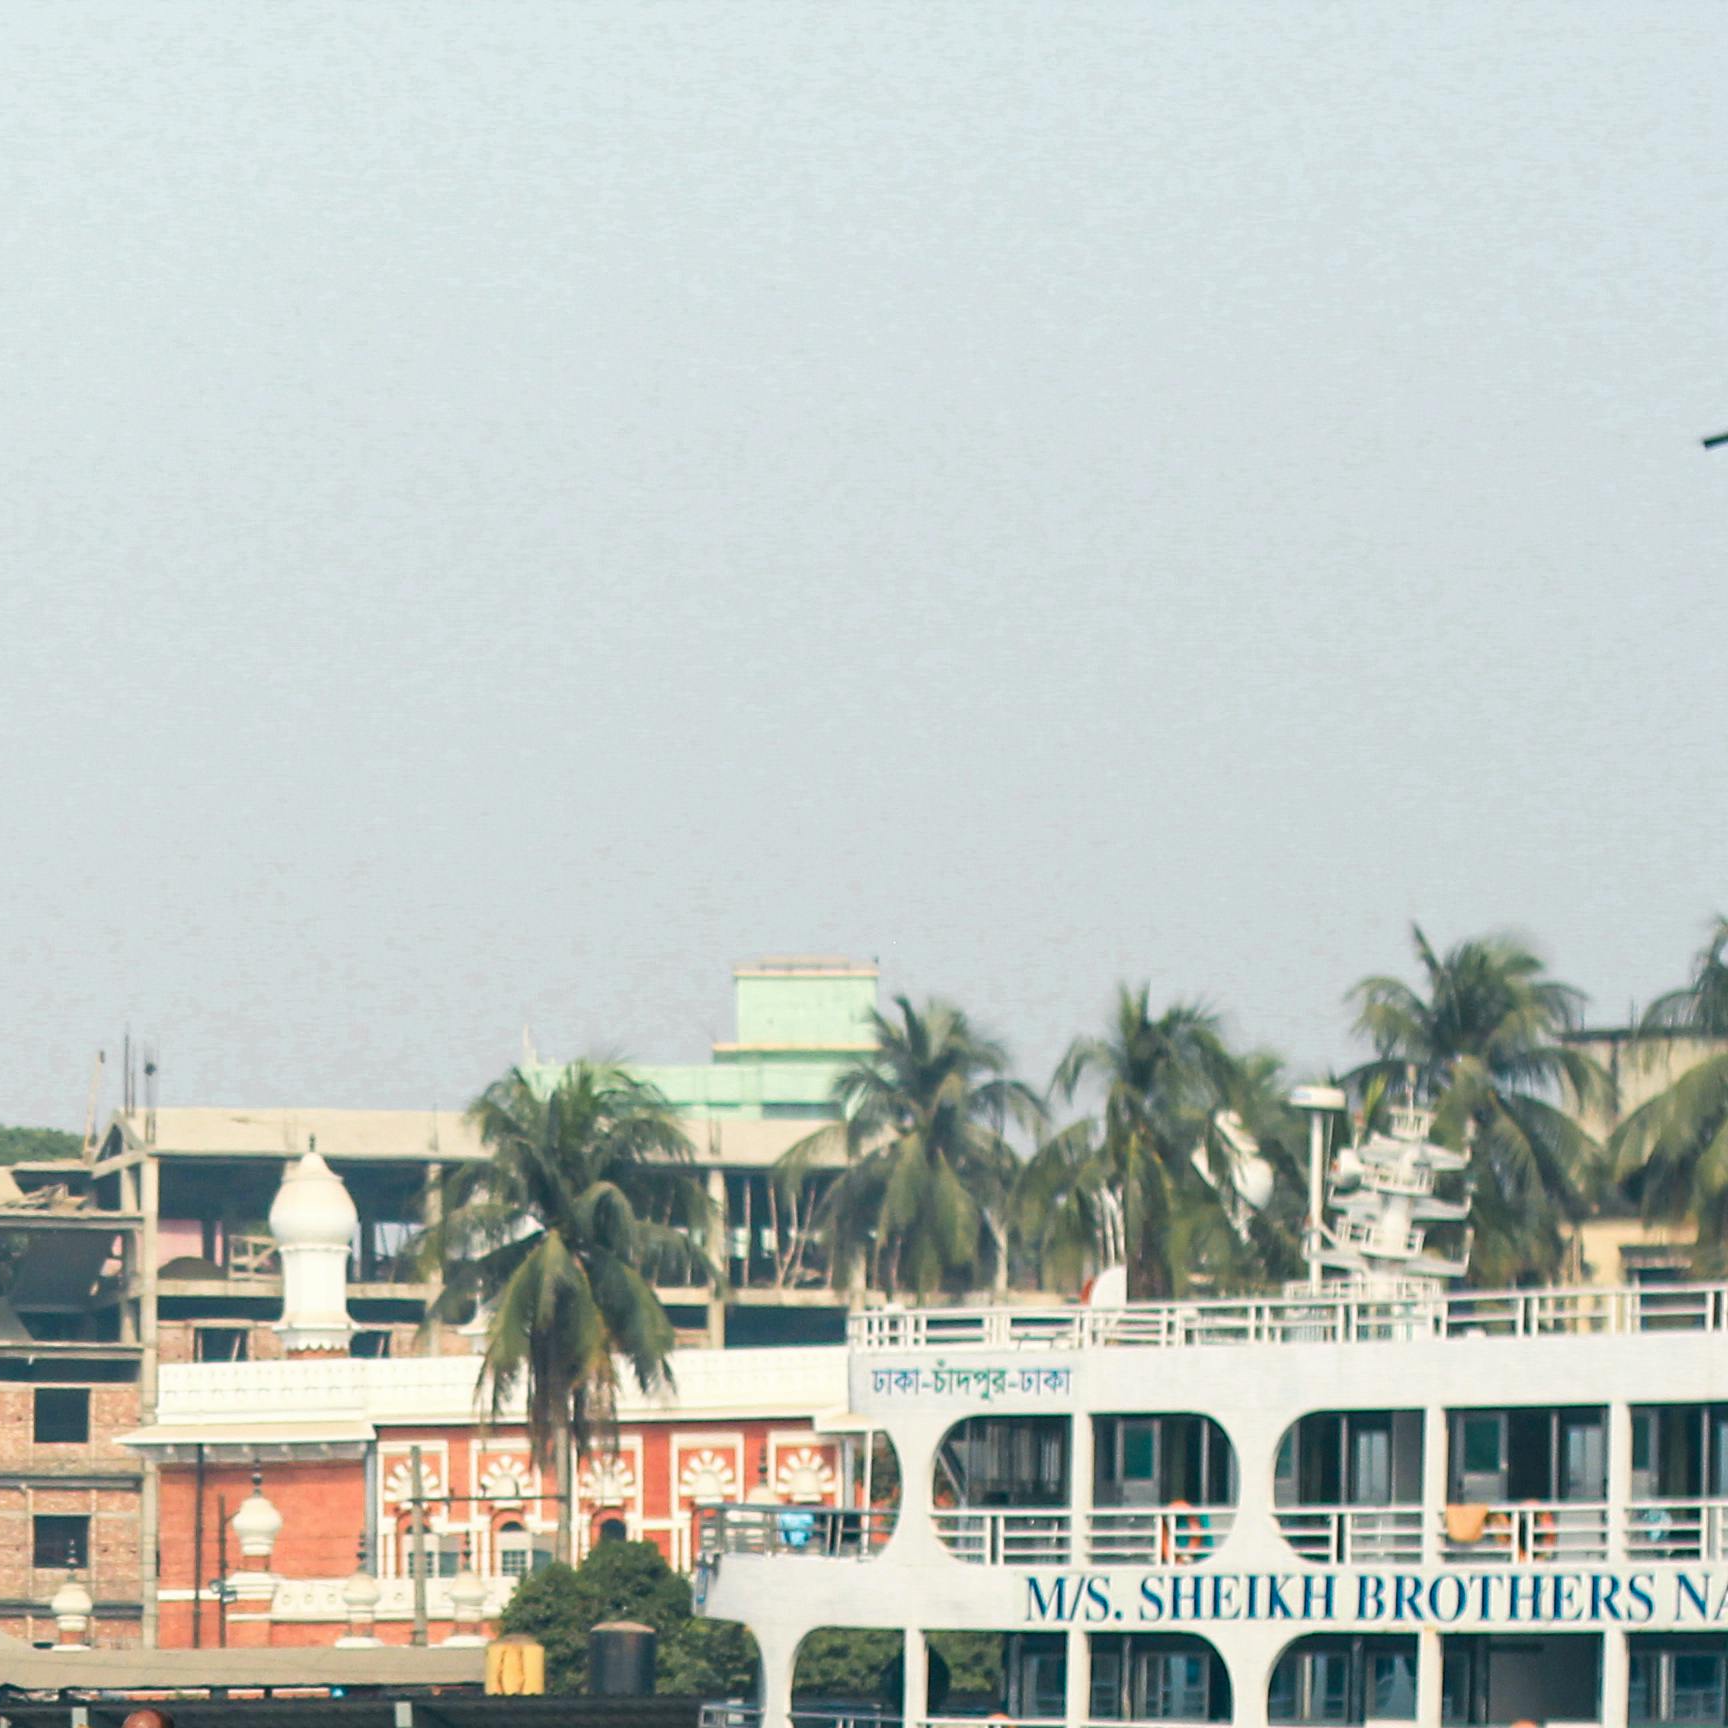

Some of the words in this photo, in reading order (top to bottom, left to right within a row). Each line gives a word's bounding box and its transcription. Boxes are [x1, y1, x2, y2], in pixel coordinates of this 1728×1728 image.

[1025, 1575, 1124, 1621] M/S.
[1138, 1574, 1337, 1621] SHEIKH
[1354, 1572, 1656, 1622] BROTHERS
